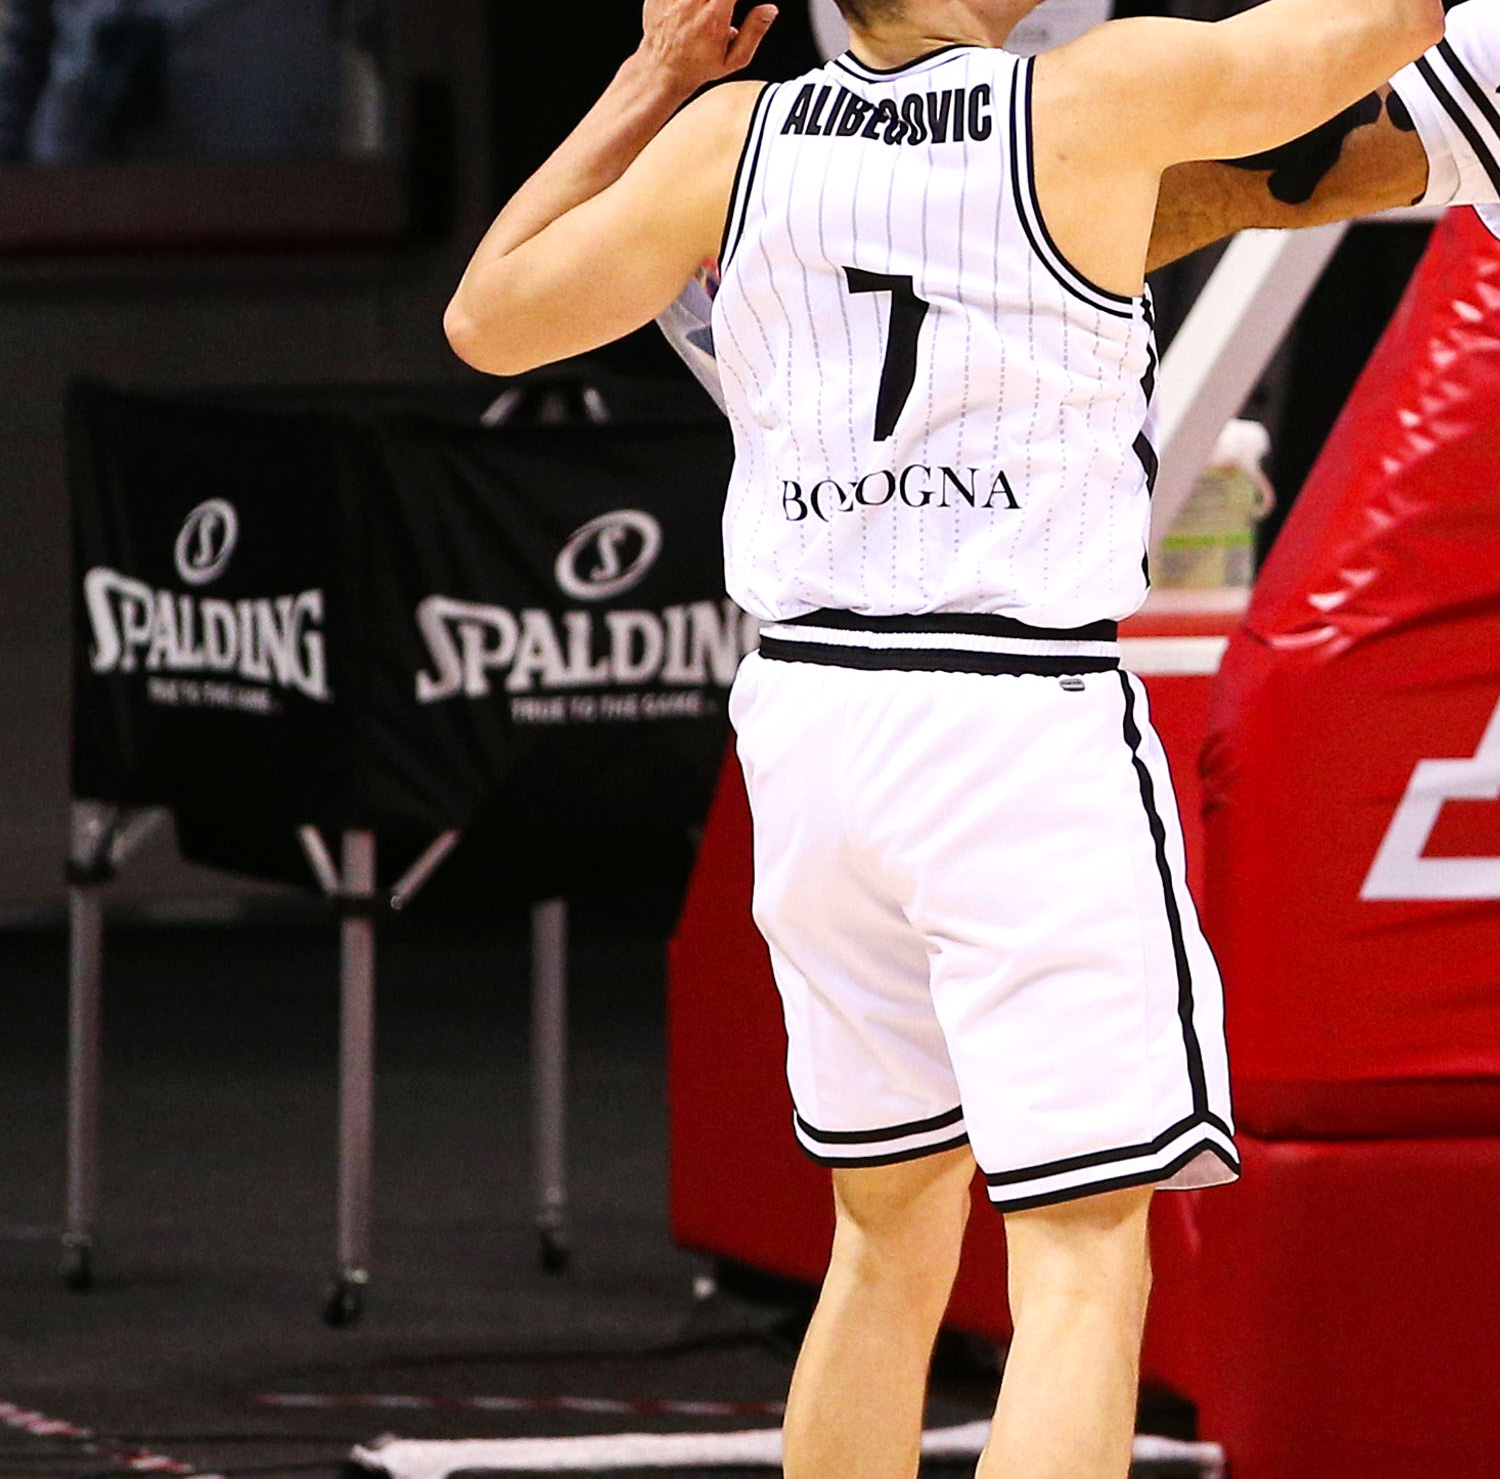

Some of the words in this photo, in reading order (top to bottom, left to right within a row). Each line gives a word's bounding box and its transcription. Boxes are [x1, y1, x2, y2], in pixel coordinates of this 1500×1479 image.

[779, 82, 993, 146] ALIBEGOVIC
[842, 266, 931, 442] 7
[83, 566, 333, 702] SPALDING
